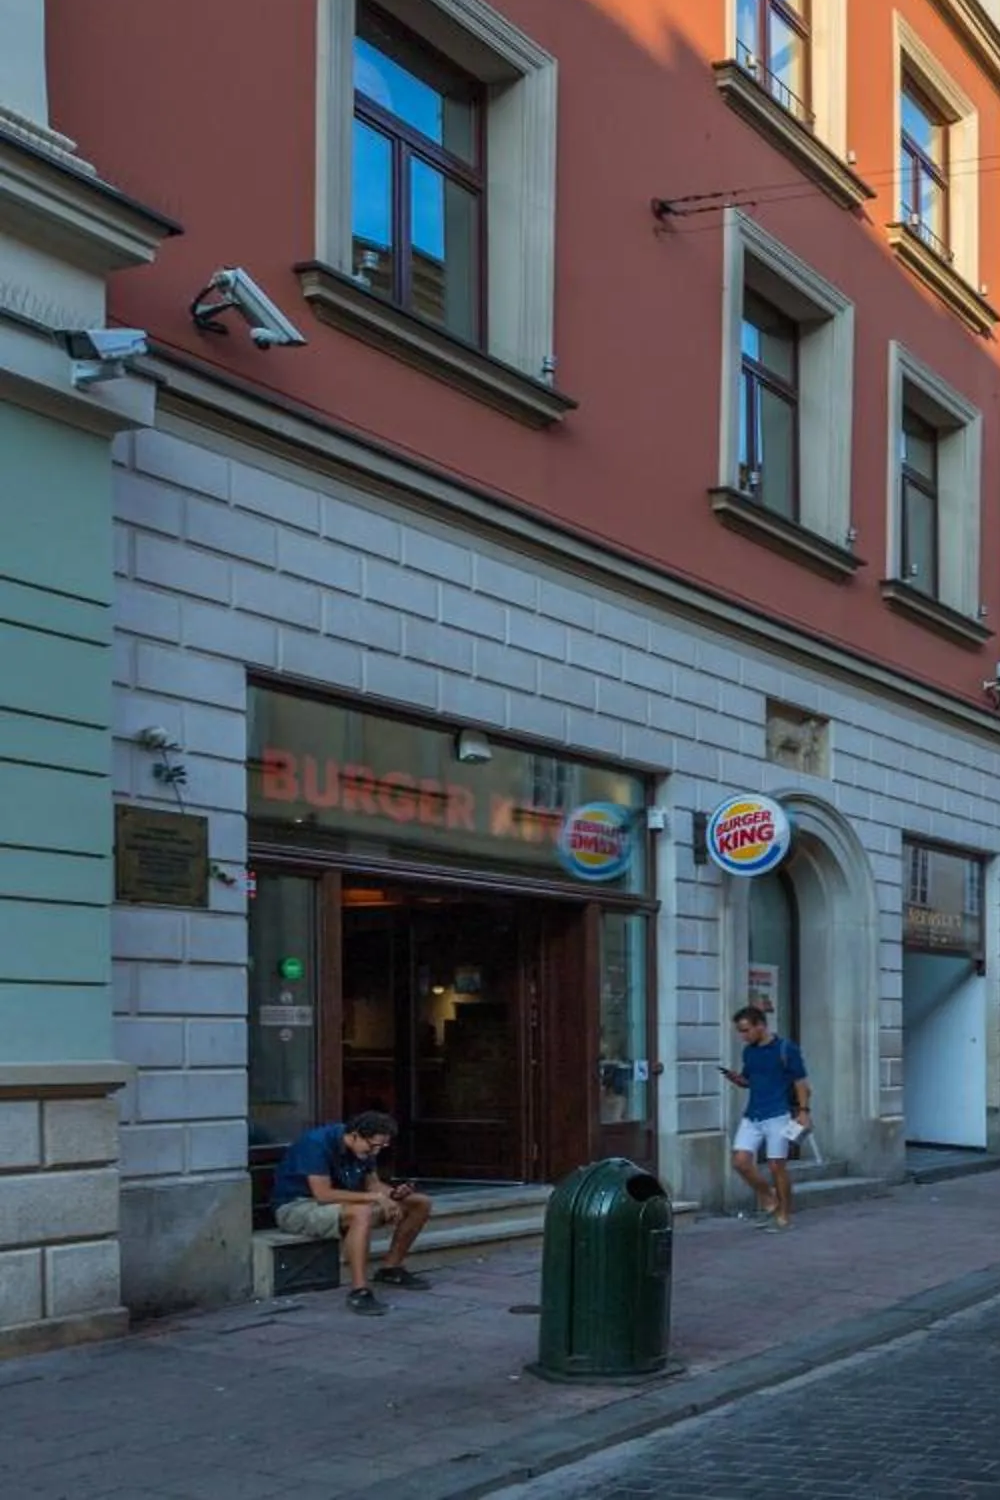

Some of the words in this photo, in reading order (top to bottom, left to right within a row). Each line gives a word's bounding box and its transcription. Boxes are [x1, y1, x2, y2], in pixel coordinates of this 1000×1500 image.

[261, 746, 476, 833] BURGER
[489, 797, 566, 843] KIN
[716, 810, 771, 837] BURGER
[718, 823, 774, 854] KING
